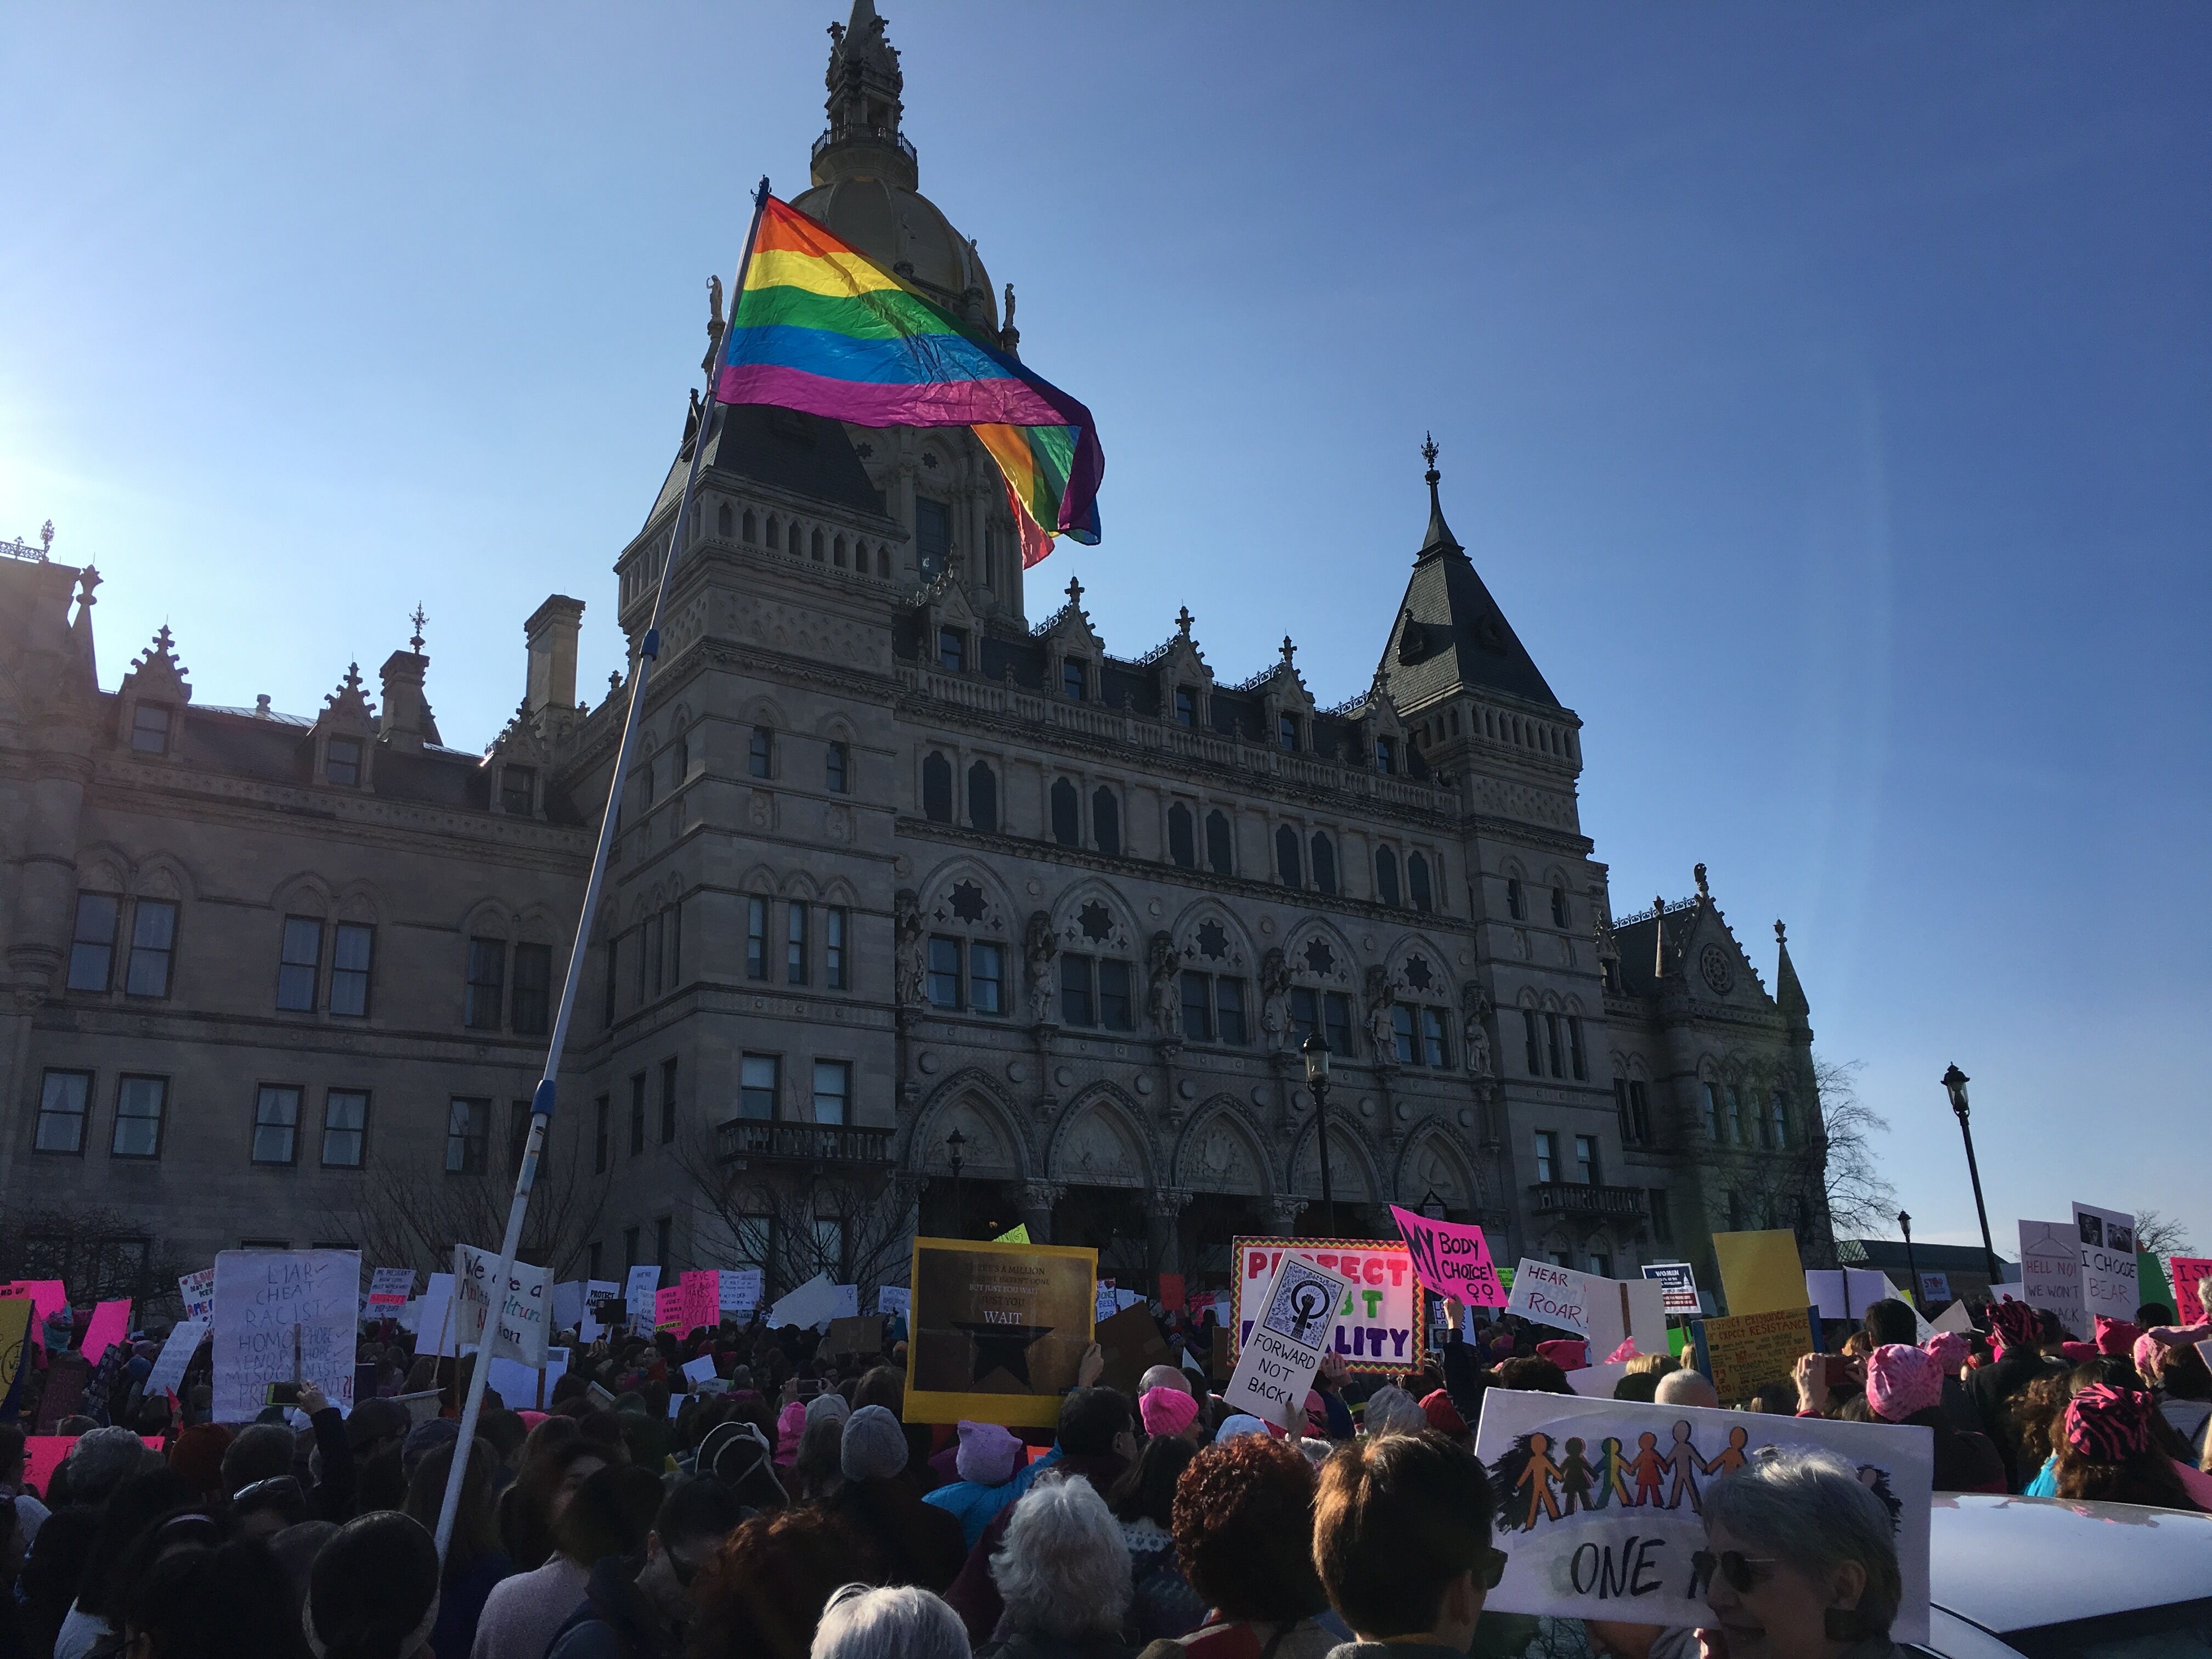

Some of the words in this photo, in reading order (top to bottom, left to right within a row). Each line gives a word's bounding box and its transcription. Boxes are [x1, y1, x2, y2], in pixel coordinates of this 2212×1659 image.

[1399, 1220, 1442, 1283] MY
[1438, 1232, 1478, 1260] BODY
[268, 1262, 312, 1284] LIAR
[1000, 1265, 1007, 1273] A
[1008, 1265, 1045, 1275] MILLION
[1441, 1260, 1494, 1281] CHOICE!
[2026, 1260, 2052, 1274] HELL
[2058, 1262, 2076, 1277] NO!
[2081, 1250, 2090, 1267] I
[2094, 1253, 2136, 1278] CHOOSE
[2177, 1265, 2190, 1281] I
[464, 1252, 484, 1279] We
[531, 1285, 542, 1298] a
[687, 1271, 710, 1282] LOVE
[1000, 1276, 1030, 1284] HAVEN'T
[1528, 1265, 1568, 1287] HEAR
[256, 1281, 314, 1305] CHEAT
[590, 1290, 615, 1299] PROTECT
[985, 1284, 1003, 1293] JUST
[1020, 1286, 1038, 1295] WAIT
[2028, 1285, 2043, 1297] WE
[2047, 1285, 2079, 1299] WON'T
[2089, 1277, 2130, 1304] BEAR
[982, 1296, 1003, 1305] JUST
[1005, 1297, 1025, 1306] YOU
[246, 1300, 321, 1328] RACIST
[984, 1310, 1022, 1325] WAIT
[1705, 1317, 1740, 1331] respect
[2052, 1308, 2079, 1323] ACK
[477, 1308, 521, 1344] Nion
[1707, 1332, 1716, 1341] or
[1719, 1329, 1745, 1340] expect
[1750, 1318, 1809, 1336] RESISTANCE
[1254, 1333, 1316, 1369] FORWARD
[1258, 1358, 1295, 1382] NOT
[1729, 1359, 1764, 1373] FEMINISM
[1571, 1536, 1666, 1599] ONE
